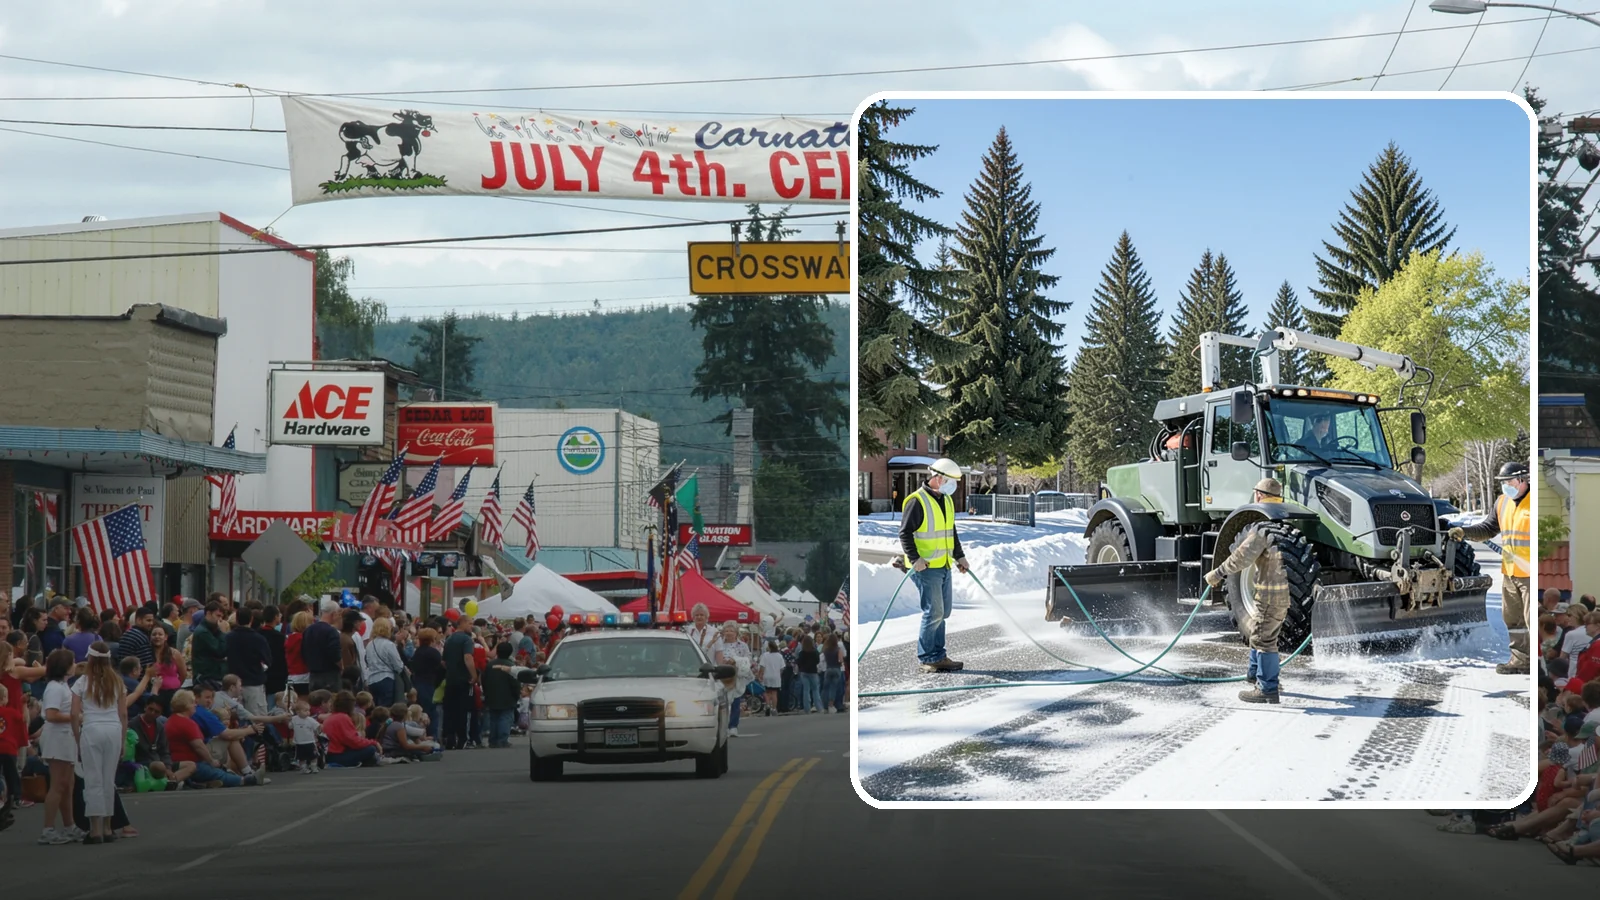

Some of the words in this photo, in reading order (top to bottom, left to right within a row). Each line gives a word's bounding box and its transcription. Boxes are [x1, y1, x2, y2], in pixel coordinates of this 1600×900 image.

[481, 141, 605, 192] JULY
[632, 150, 747, 198] 4th.
[696, 254, 850, 280] CROSSWA
[282, 380, 373, 420] ACE
[406, 409, 453, 422] CEDAR
[283, 421, 371, 437] Hardware
[353, 467, 386, 482] Simpl
[95, 484, 124, 495] Vincent
[126, 485, 136, 495] de
[137, 485, 155, 495] Paul
[212, 516, 331, 535] HARDARE
[688, 526, 741, 535] CRNATION
[699, 535, 730, 543] GLASS
